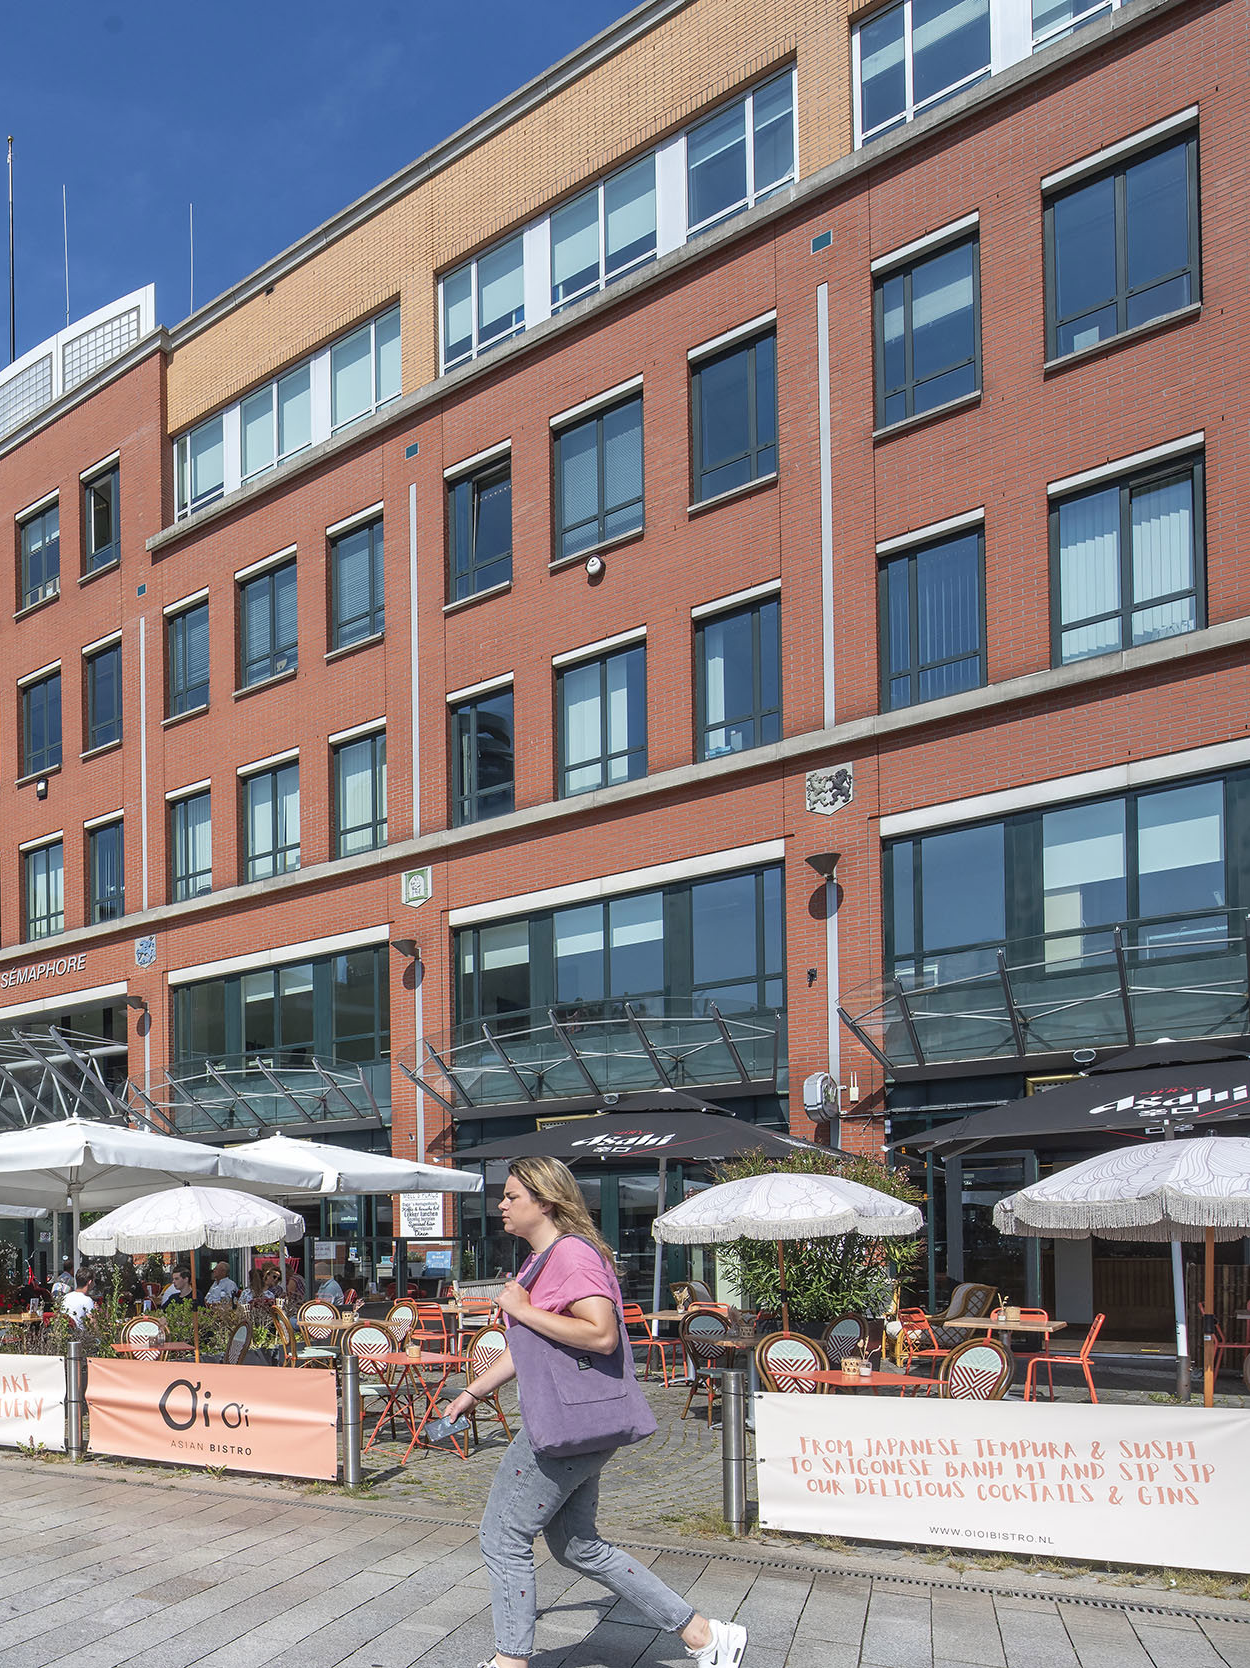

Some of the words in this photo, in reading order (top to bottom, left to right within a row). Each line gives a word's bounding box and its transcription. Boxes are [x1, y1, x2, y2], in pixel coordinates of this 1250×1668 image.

[0, 953, 88, 989] SÉMAPHORE
[1088, 1084, 1249, 1115] Asahi
[570, 1133, 677, 1147] Asahi
[170, 1439, 204, 1451] ASIAN
[209, 1443, 252, 1456] BISTRO
[799, 1436, 853, 1458] FROM
[864, 1437, 963, 1458] JAPANESE
[974, 1438, 1077, 1460] TEMPURA
[1090, 1440, 1106, 1460] &
[1119, 1440, 1201, 1461] SUSHI
[788, 1455, 812, 1475] TO
[823, 1457, 933, 1477] SAIGONESE
[945, 1460, 1003, 1480] BANH
[1017, 1463, 1047, 1480] MI
[1061, 1462, 1105, 1481] AND
[1119, 1462, 1160, 1482] SIP
[1174, 1463, 1216, 1483] SIP
[806, 1478, 846, 1497] OUR
[855, 1479, 965, 1500] DELICIOUS
[976, 1481, 1095, 1504] COCKTAILS
[1108, 1485, 1124, 1506] &
[1138, 1485, 1201, 1507] GINS
[928, 1525, 1056, 1546] WWW.OIOIBISTRO.NL
